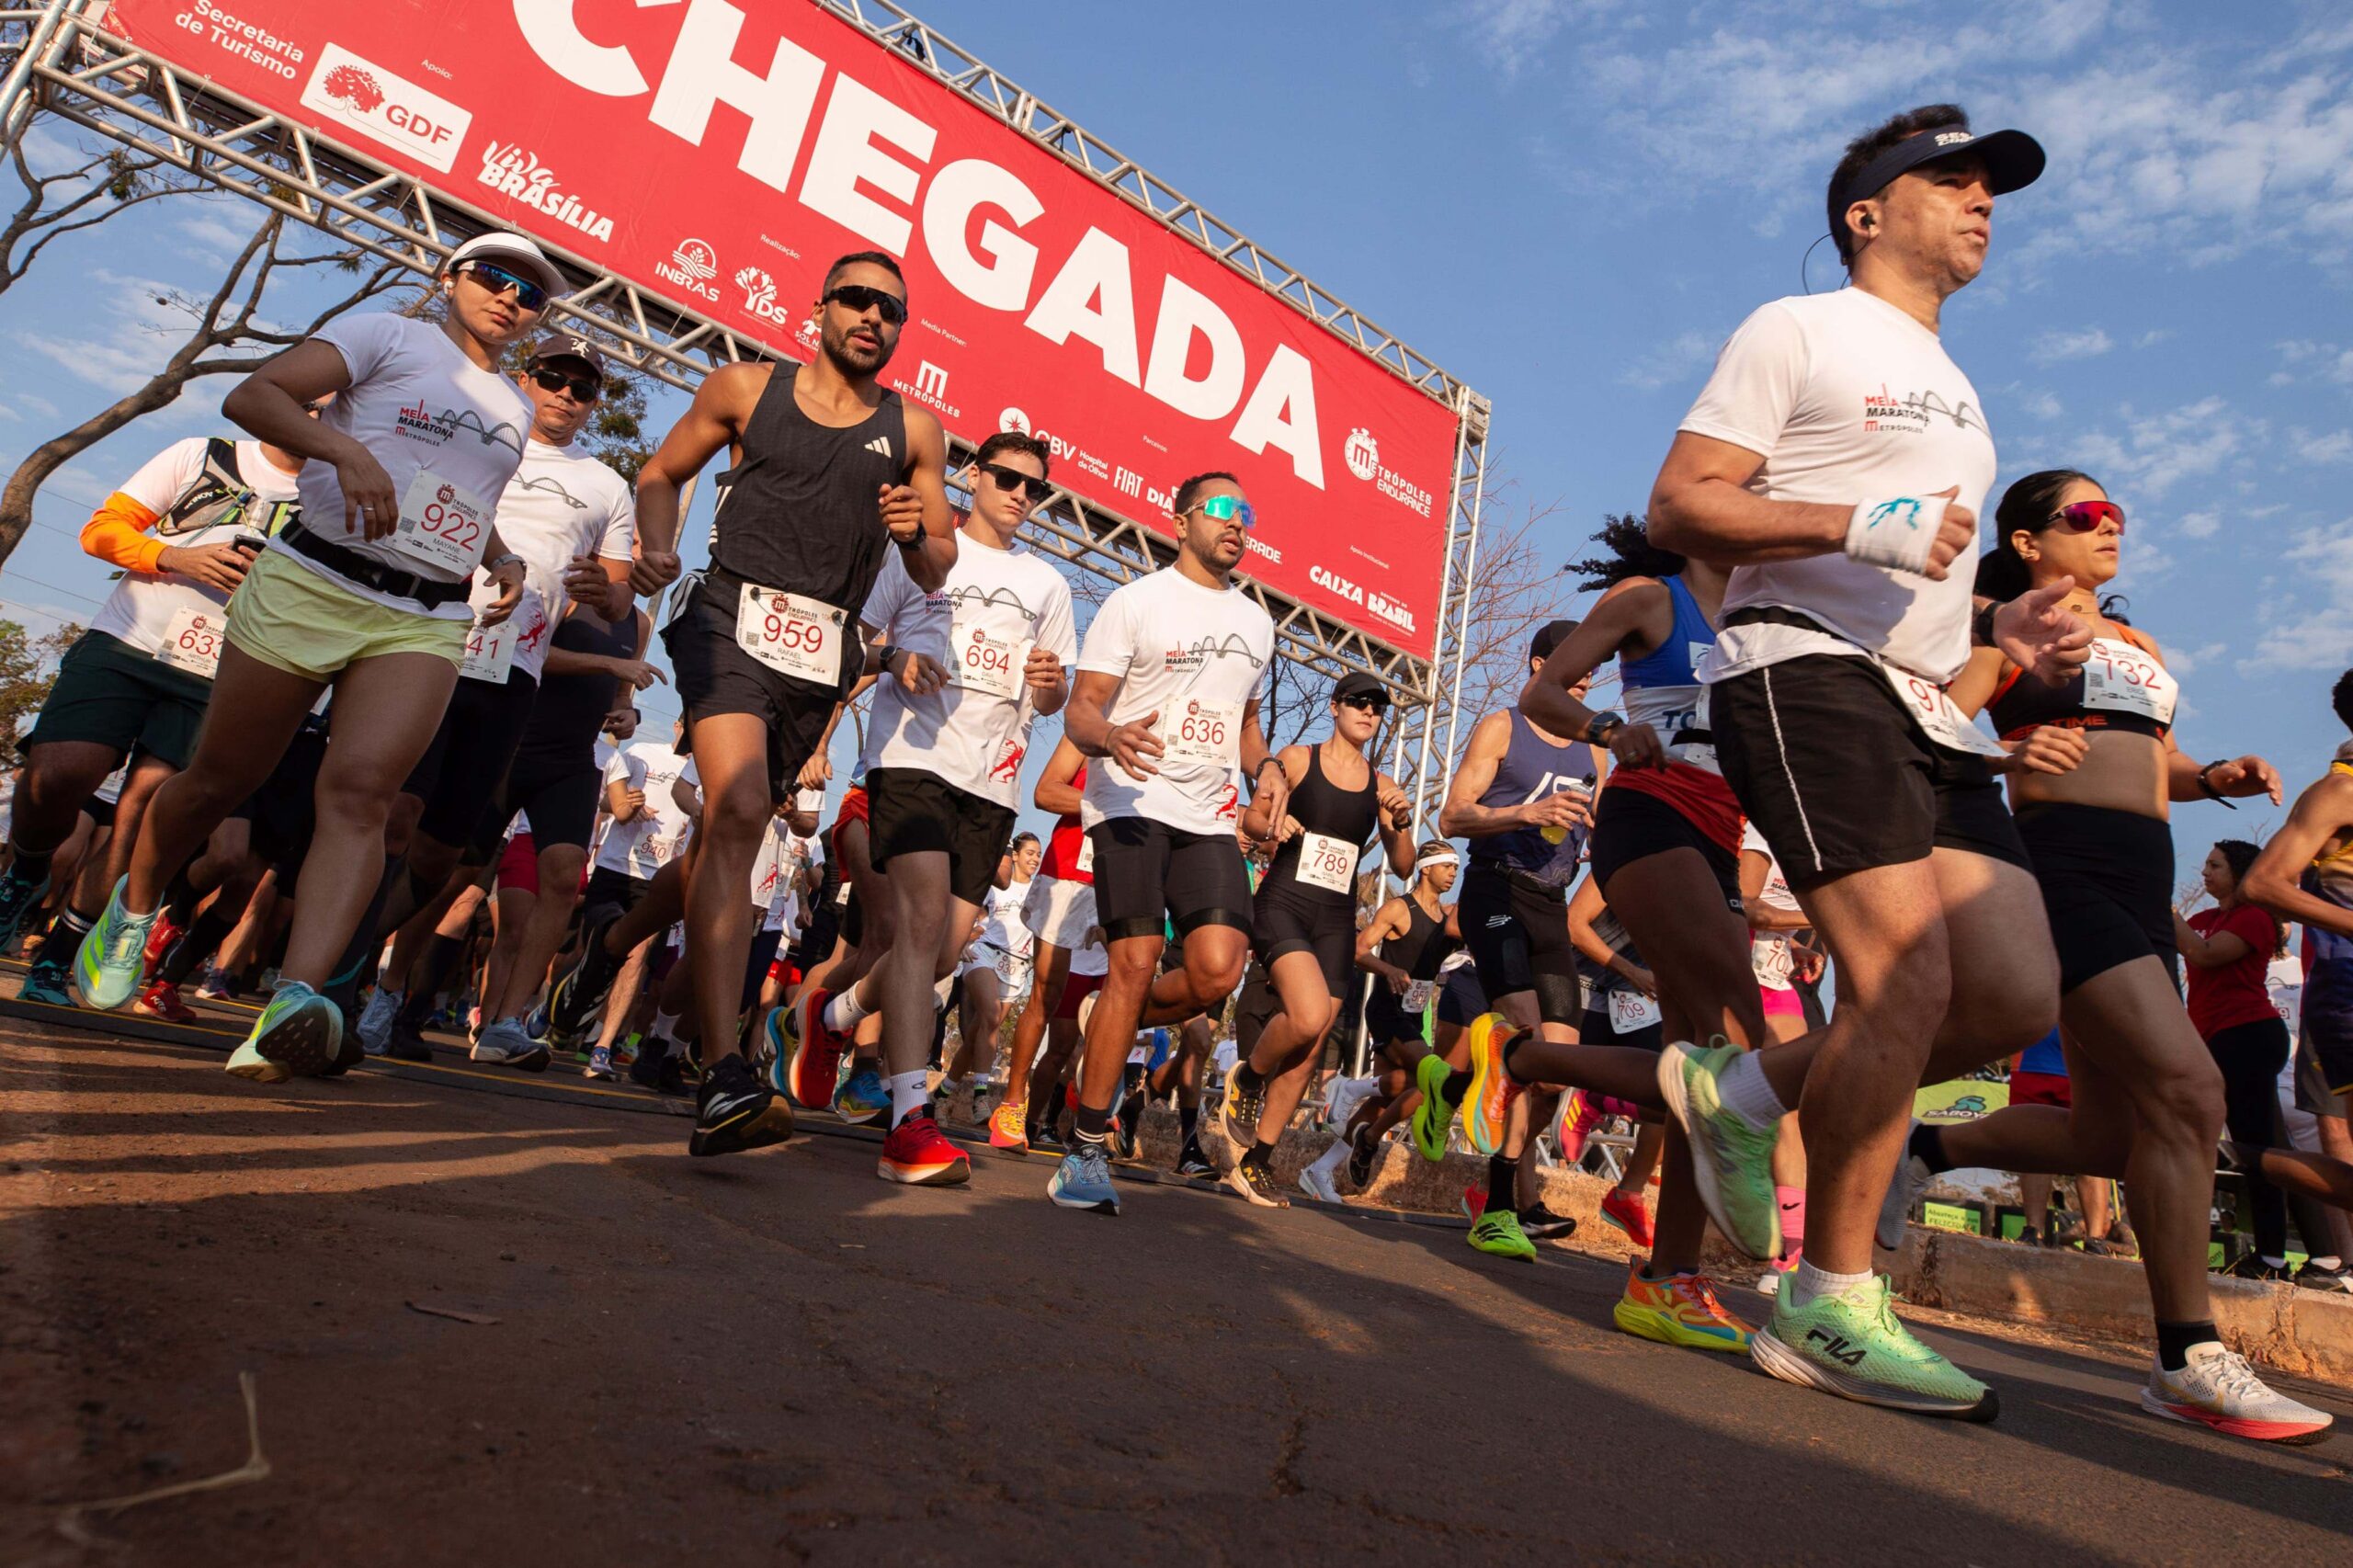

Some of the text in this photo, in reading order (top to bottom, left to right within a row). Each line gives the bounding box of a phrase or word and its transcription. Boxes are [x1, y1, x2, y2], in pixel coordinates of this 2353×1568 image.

[194, 0, 304, 63] Secretaria
[175, 12, 296, 80] de Turismo
[421, 59, 453, 80] Apoio:
[386, 103, 453, 144] GDF
[482, 140, 561, 187] Viva
[477, 162, 615, 243] BRASÍLIA
[510, 0, 1325, 491] CHEGADA
[760, 233, 801, 260] Realização:
[654, 262, 720, 302] INBRAS
[920, 318, 967, 347] Media Partner:
[1865, 383, 1900, 406] MEIA
[400, 399, 429, 422] MEIA
[1866, 407, 1930, 427] MARATONA
[398, 416, 454, 441] MARATONA
[1077, 460, 1108, 481] de Olhos
[1079, 450, 1108, 470] Hospital
[1113, 465, 1143, 499] FIAT
[1377, 479, 1431, 517] ENDURANCE
[421, 504, 480, 551] 922
[1245, 536, 1282, 563] ERADE
[1309, 565, 1363, 606] CAIXA
[1367, 592, 1416, 633] BRASIL
[467, 635, 499, 660] 41
[764, 614, 823, 653] 959
[966, 644, 1010, 675] 694
[1165, 641, 1187, 657] MEIA
[2095, 656, 2161, 689] 732
[1181, 717, 1225, 744] 636
[2051, 714, 2108, 729] TIME
[641, 842, 666, 858] 940
[1313, 850, 1347, 875] 789
[997, 961, 1016, 975] 930
[1618, 1002, 1644, 1019] 709
[1806, 1329, 1867, 1366] FILA
